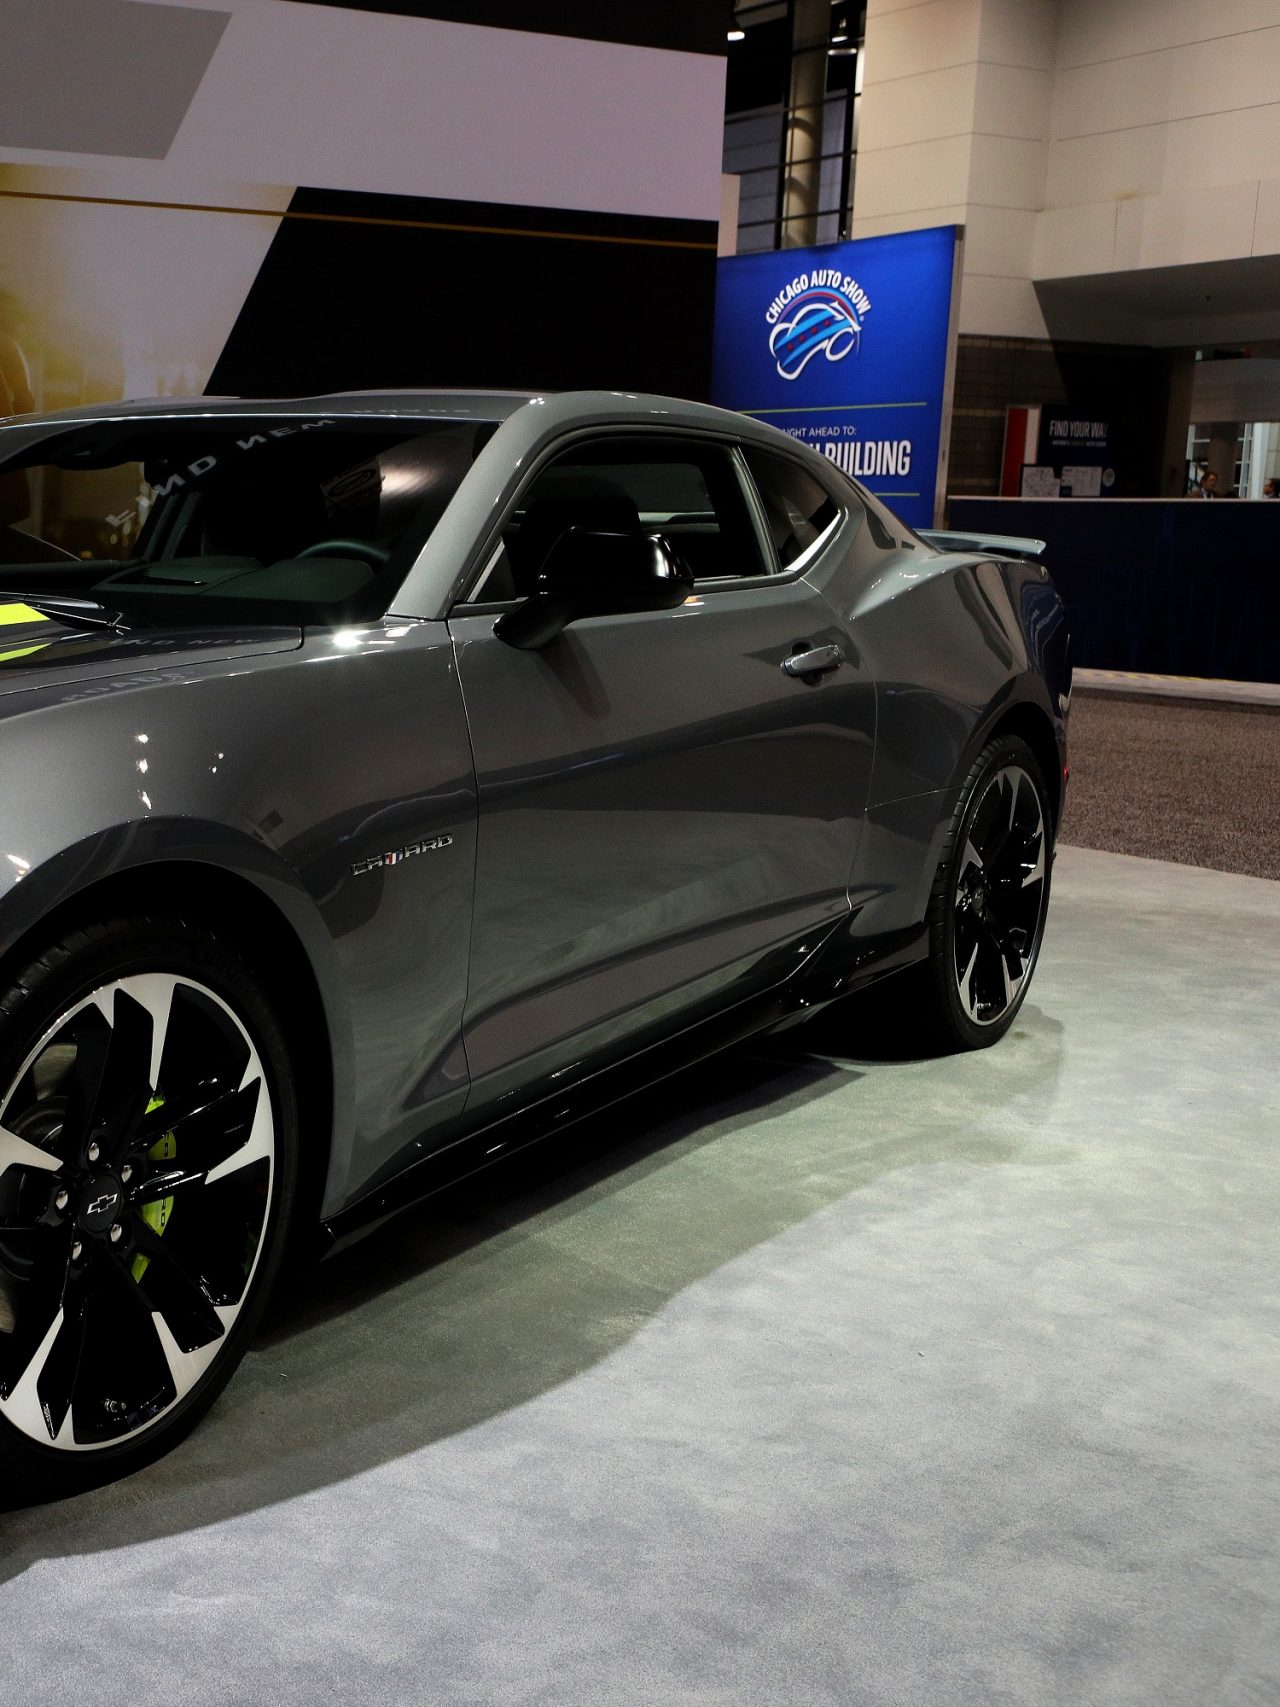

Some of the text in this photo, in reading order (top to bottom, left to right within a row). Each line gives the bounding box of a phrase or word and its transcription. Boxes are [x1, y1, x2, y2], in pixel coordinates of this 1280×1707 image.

[765, 269, 872, 324] CHICAGO AUTO SHOW
[808, 426, 840, 437] AHEAD
[842, 425, 857, 436] TO:
[1049, 420, 1069, 437] FIND
[1070, 420, 1090, 437] YOUR
[824, 439, 912, 476] BUILDING
